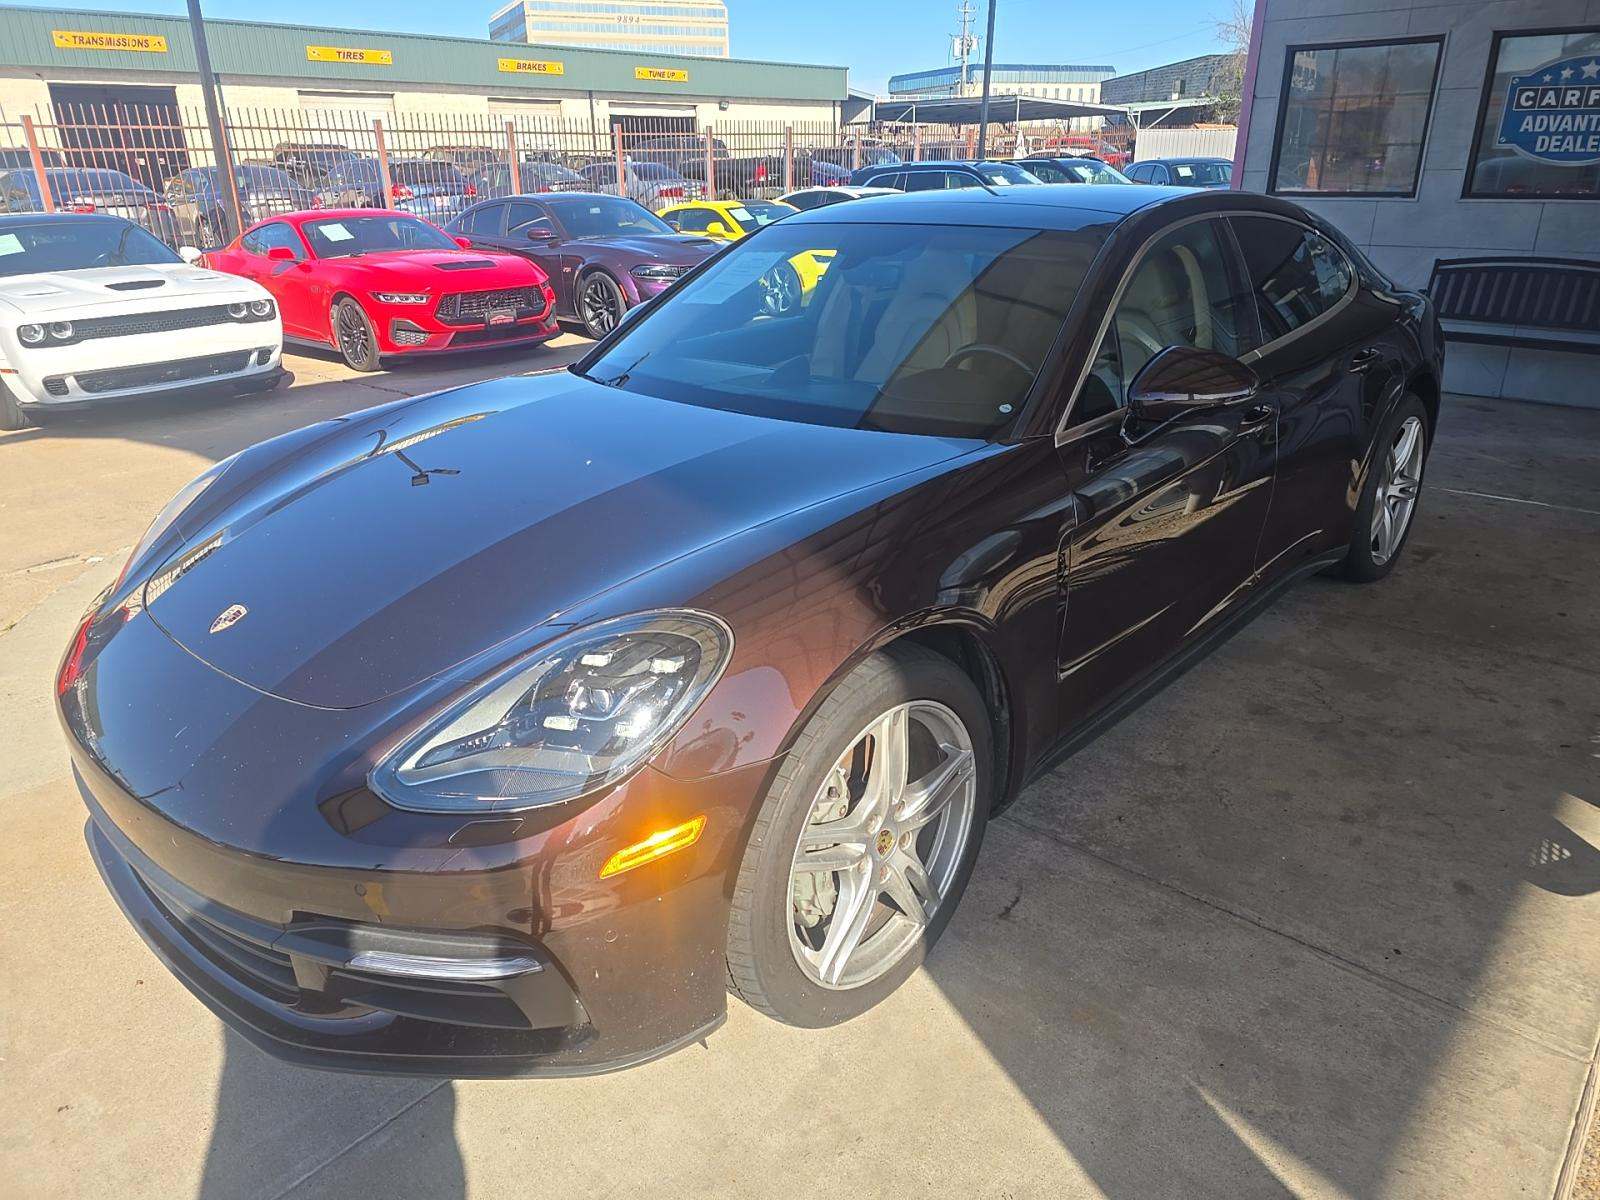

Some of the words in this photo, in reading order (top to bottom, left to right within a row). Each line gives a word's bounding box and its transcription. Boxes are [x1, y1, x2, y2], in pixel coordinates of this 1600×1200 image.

[616, 15, 640, 24] 9894
[72, 35, 150, 48] TRANSMISSIONS
[336, 50, 365, 60] TIRES
[516, 62, 547, 72] BRAKES
[649, 70, 666, 79] TUNE
[667, 71, 676, 79] UP
[1519, 114, 1600, 132] ADVANT
[1535, 134, 1600, 153] DEALE
